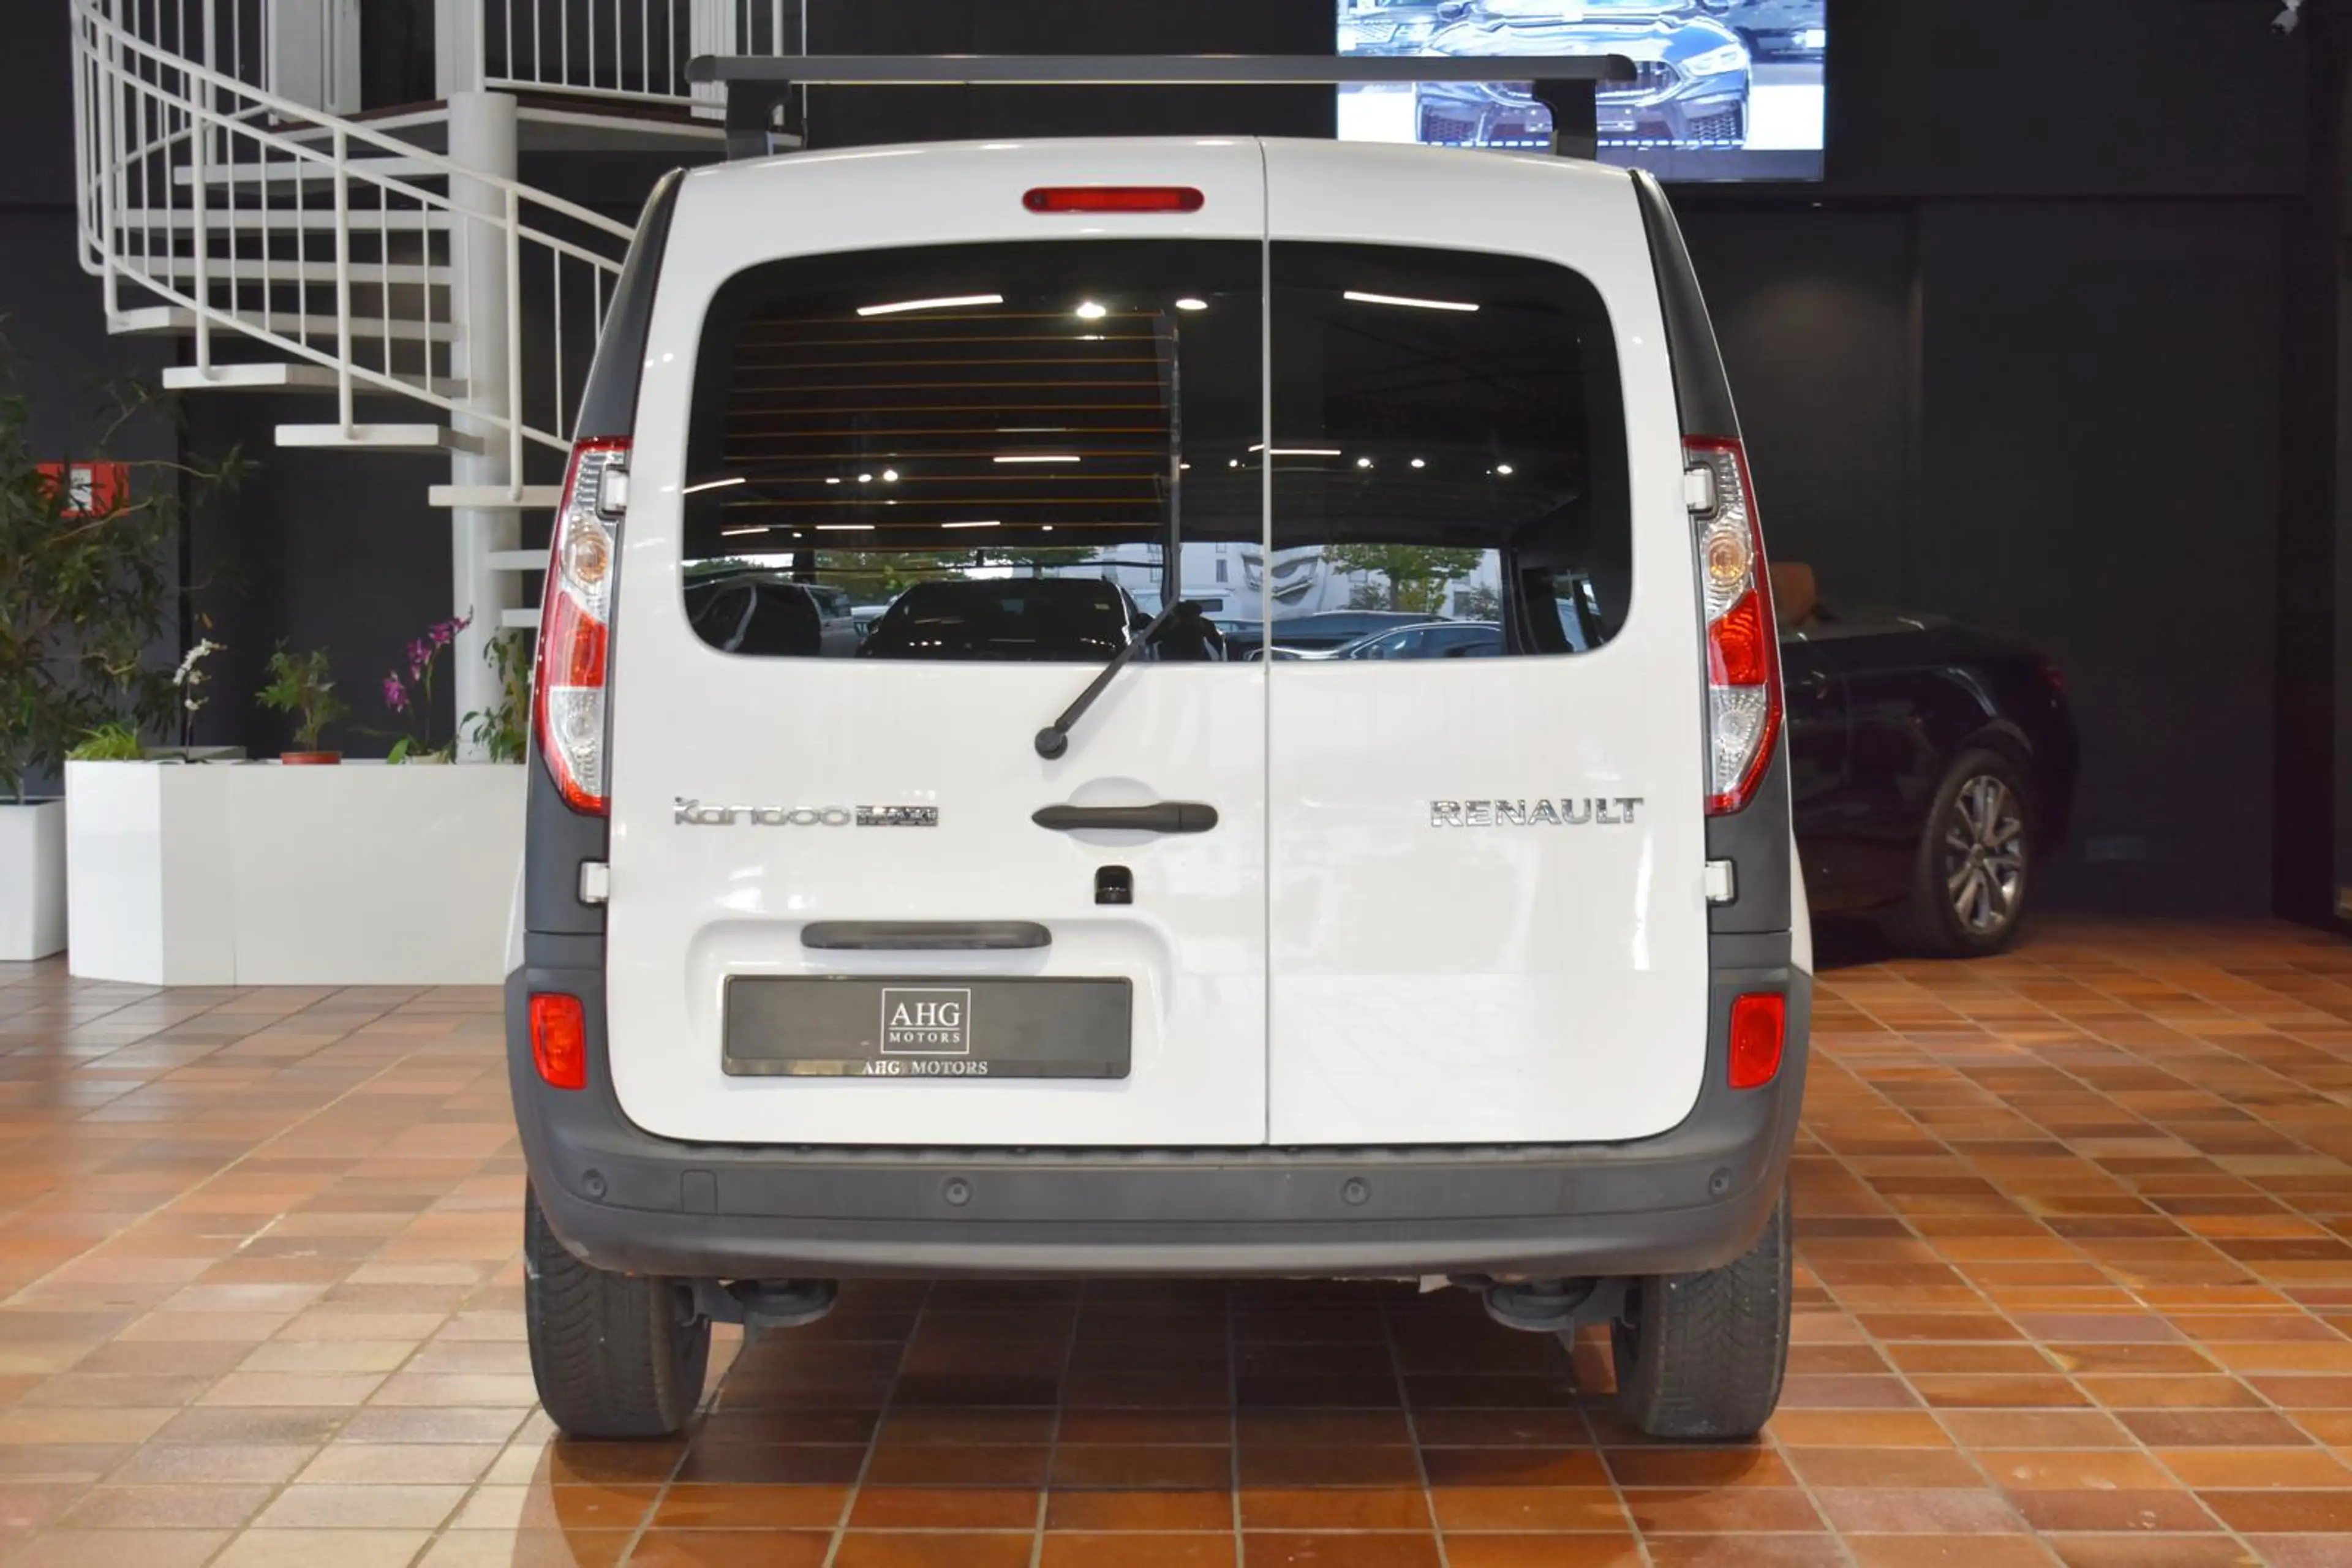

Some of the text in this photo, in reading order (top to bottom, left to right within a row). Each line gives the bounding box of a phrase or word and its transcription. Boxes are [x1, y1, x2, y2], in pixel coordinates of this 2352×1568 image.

[1430, 797, 1645, 827] RENAULT
[890, 1001, 962, 1027] AHG
[889, 1031, 961, 1043] MOTORS
[861, 1060, 989, 1075] AHG MOTORS
